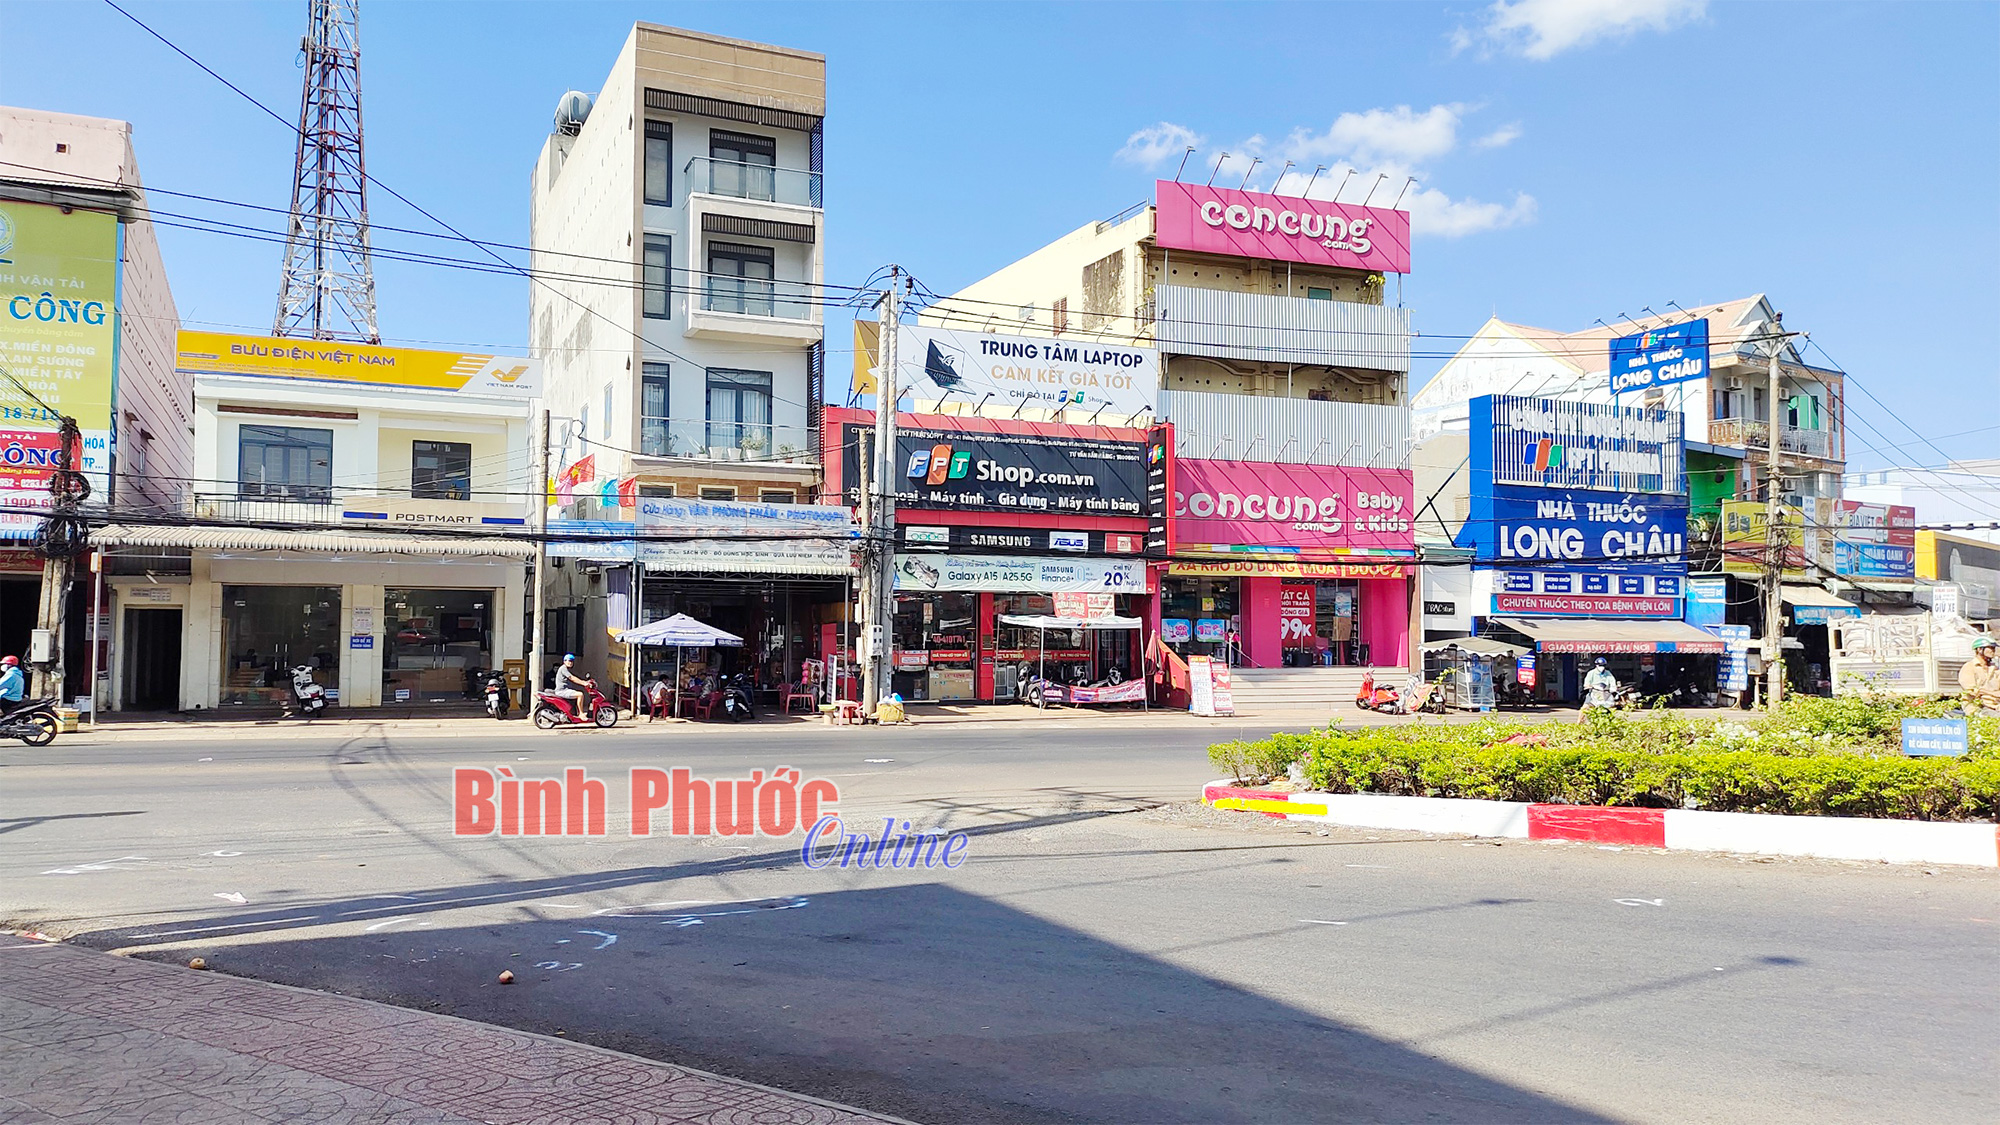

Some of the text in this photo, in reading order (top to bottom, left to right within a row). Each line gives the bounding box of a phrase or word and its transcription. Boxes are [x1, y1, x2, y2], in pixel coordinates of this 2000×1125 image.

[1200, 200, 1374, 254] concung
[20, 275, 85, 289] VẬN TẢI
[9, 291, 106, 326] CÔNG
[56, 344, 95, 356] ĐÔNG
[231, 344, 268, 357] BƯU
[271, 347, 315, 360] ĐIỆN
[318, 349, 354, 364] VIỆT
[359, 354, 395, 366] NAM
[980, 340, 1143, 368] TRUNG TÂM LAPTOP
[1629, 345, 1683, 368] NHÀ THUỐC
[37, 356, 85, 368] SƯƠNG
[55, 369, 82, 380] TÂY
[991, 363, 1133, 390] CAM KẾT GIÁ TỐT
[1612, 357, 1702, 390] LONG CHÂU
[1009, 388, 1025, 398] CHỈ
[1088, 396, 1105, 404] Shop
[976, 459, 1094, 487] Shop.com.vn
[930, 491, 956, 504] Máy
[959, 492, 984, 504] tính
[998, 493, 1018, 506] Gia
[1020, 493, 1047, 509] dụng
[1058, 497, 1083, 511] Máy
[1086, 497, 1108, 510] tính
[1111, 498, 1140, 513] bảng
[1356, 491, 1404, 513] Baby
[1537, 494, 1647, 524] NHÀ THUỐC
[395, 513, 473, 523] POSTMART
[712, 504, 747, 518] PHÒNG
[750, 504, 778, 519] PHẨM
[1292, 522, 1319, 532] .com
[1354, 513, 1409, 533] & Kids
[557, 544, 581, 553] KHU
[587, 543, 611, 553] PHỐ
[970, 534, 1031, 547] SAMSUNG
[1053, 538, 1083, 547] ASUS
[1500, 524, 1682, 563] LONG CHÂU
[1887, 550, 1903, 561] OANH
[1303, 564, 1338, 574] MUA
[948, 571, 982, 583] Galaxy
[984, 572, 998, 581] A15
[1041, 574, 1074, 582] Finance+
[1104, 572, 1123, 587] 20
[1296, 589, 1310, 600] CẢ
[1502, 597, 1671, 614] CHUYÊN THUỐC THEO TOA BỆNH VIỆN LỚN
[1948, 603, 1956, 612] XE
[1548, 643, 1574, 651] GIAO
[1577, 641, 1606, 651] HÀNG
[1629, 642, 1650, 652] NƠI
